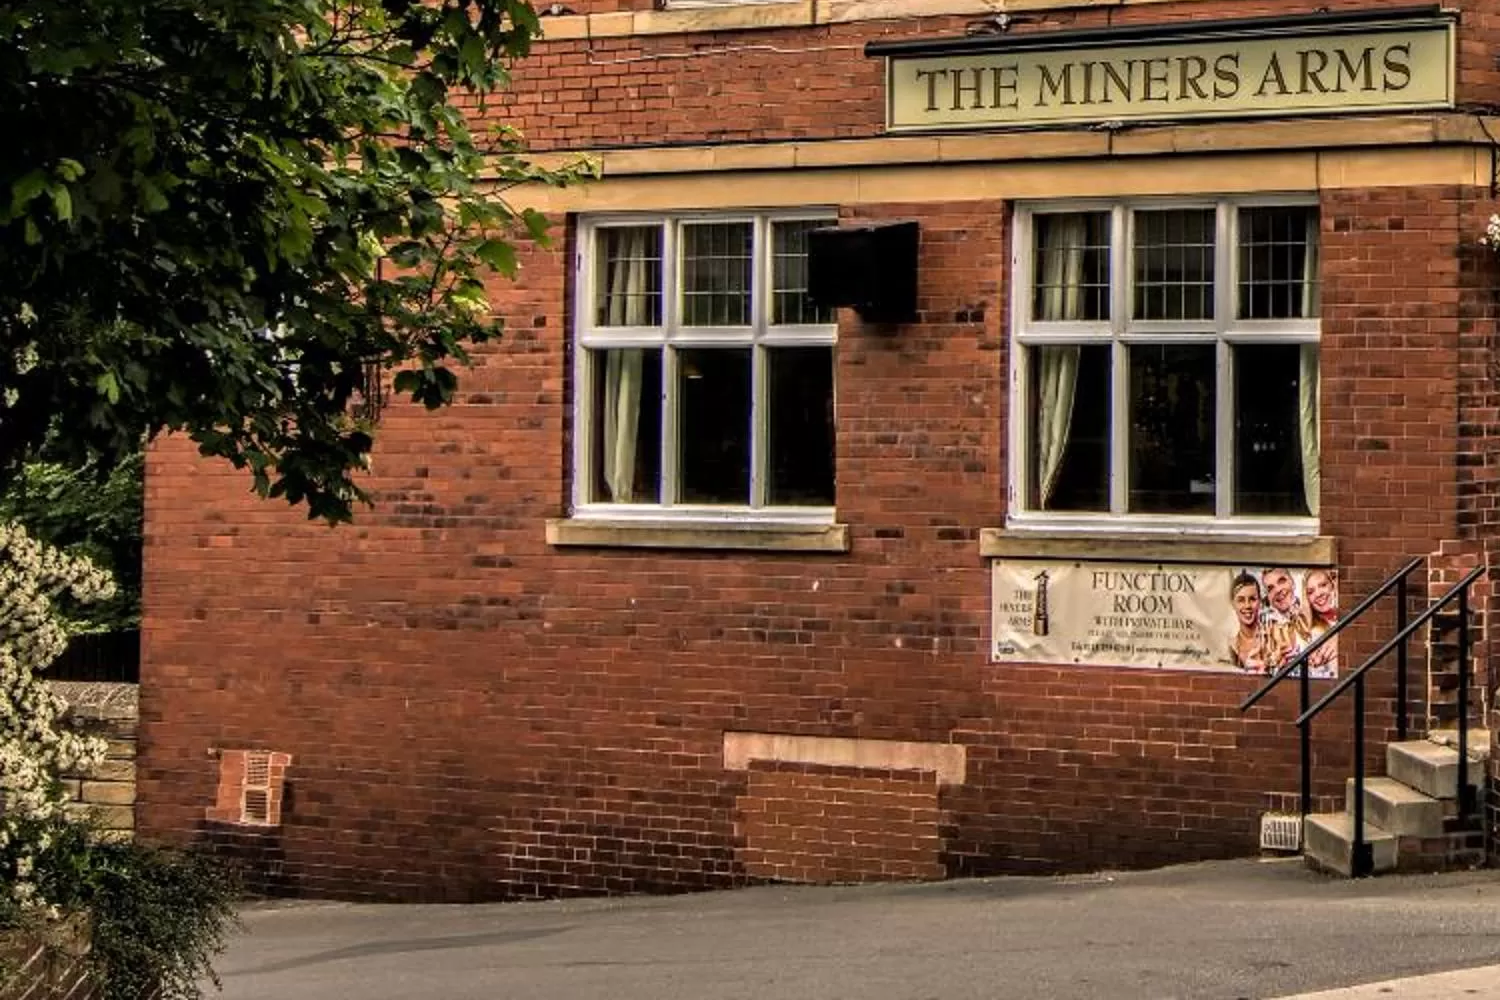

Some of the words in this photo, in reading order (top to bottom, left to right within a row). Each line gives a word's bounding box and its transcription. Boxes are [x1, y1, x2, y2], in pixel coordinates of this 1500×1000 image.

[916, 66, 1019, 112] THE
[1034, 52, 1242, 107] MINERS
[1256, 41, 1414, 97] ARMS
[1092, 571, 1197, 593] FUNCTION
[1113, 593, 1174, 614] ROOM
